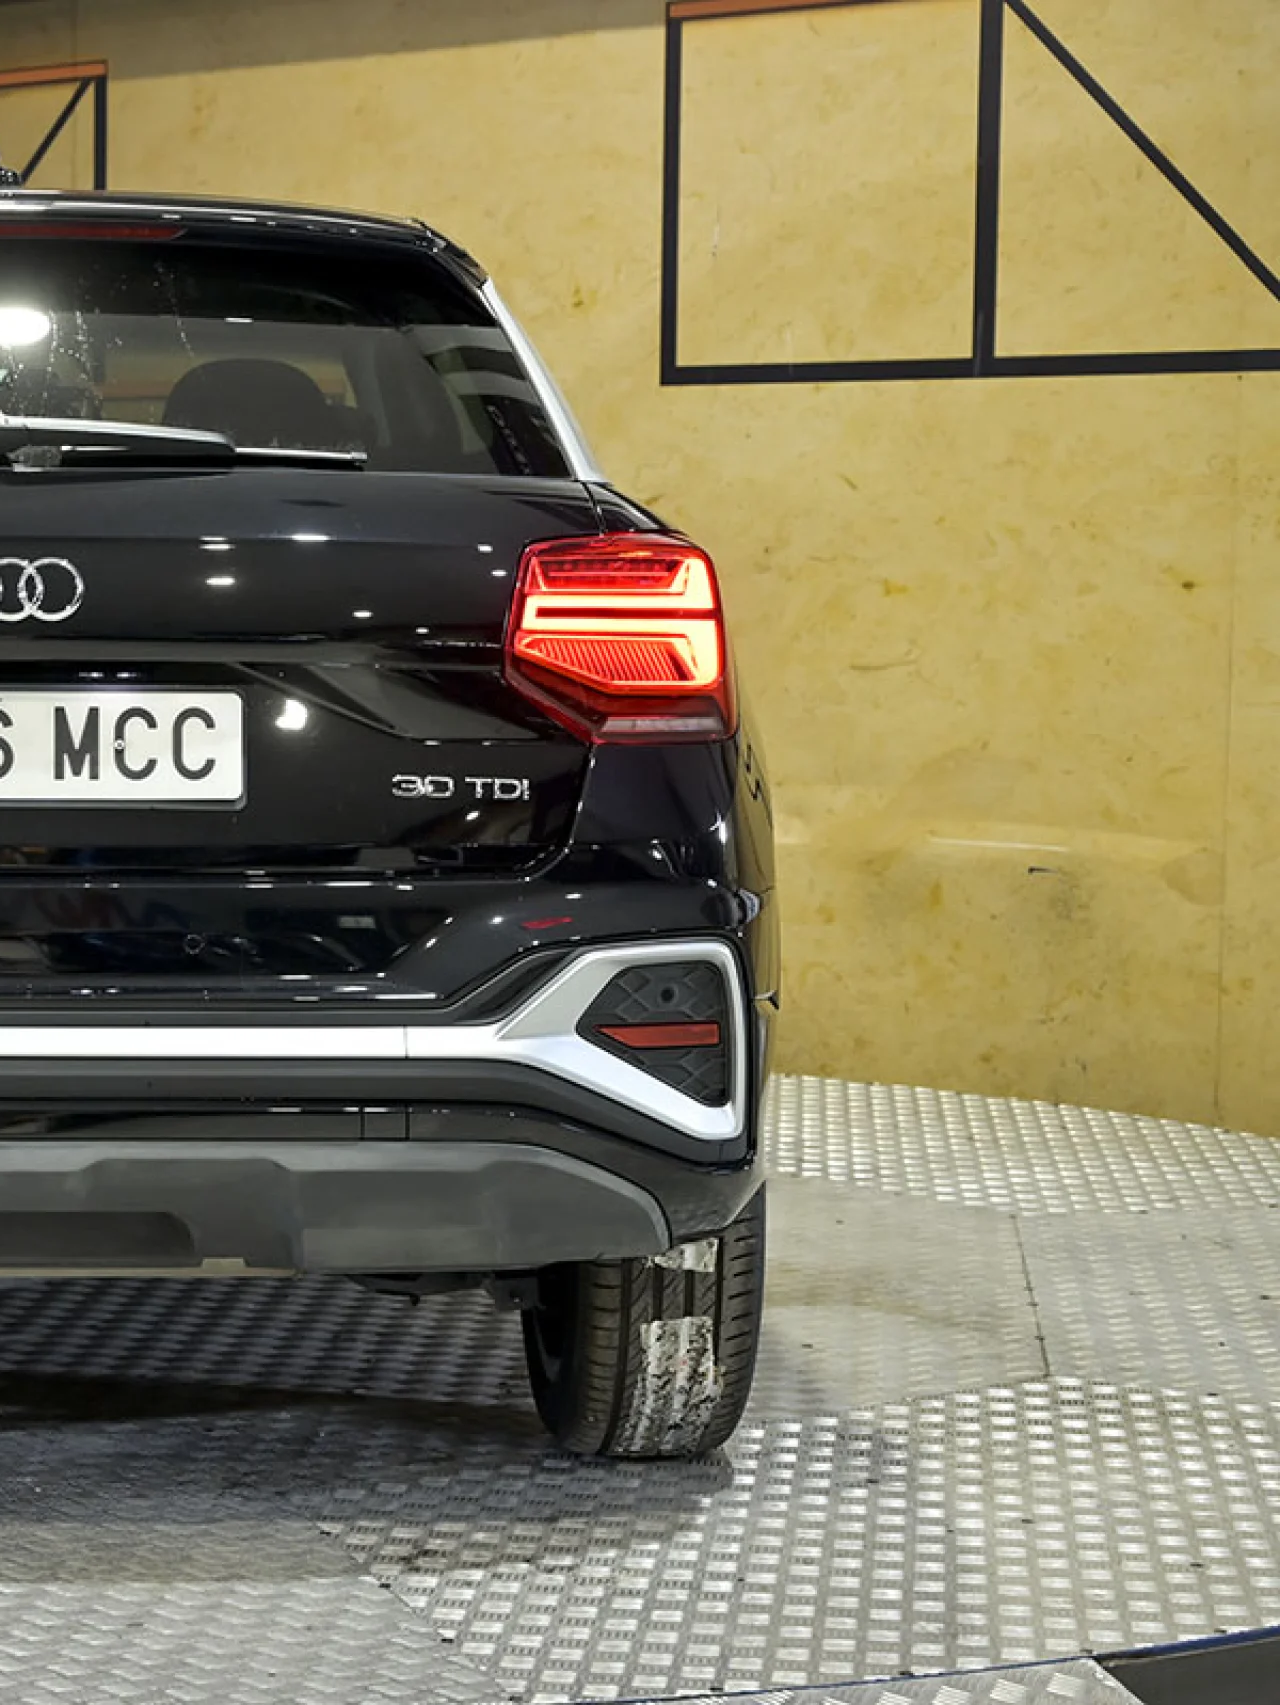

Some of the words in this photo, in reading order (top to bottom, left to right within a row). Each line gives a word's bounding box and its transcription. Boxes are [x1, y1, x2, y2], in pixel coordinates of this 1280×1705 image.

[52, 706, 217, 782] MCC
[391, 774, 456, 798] 30
[464, 776, 530, 801] TDI
